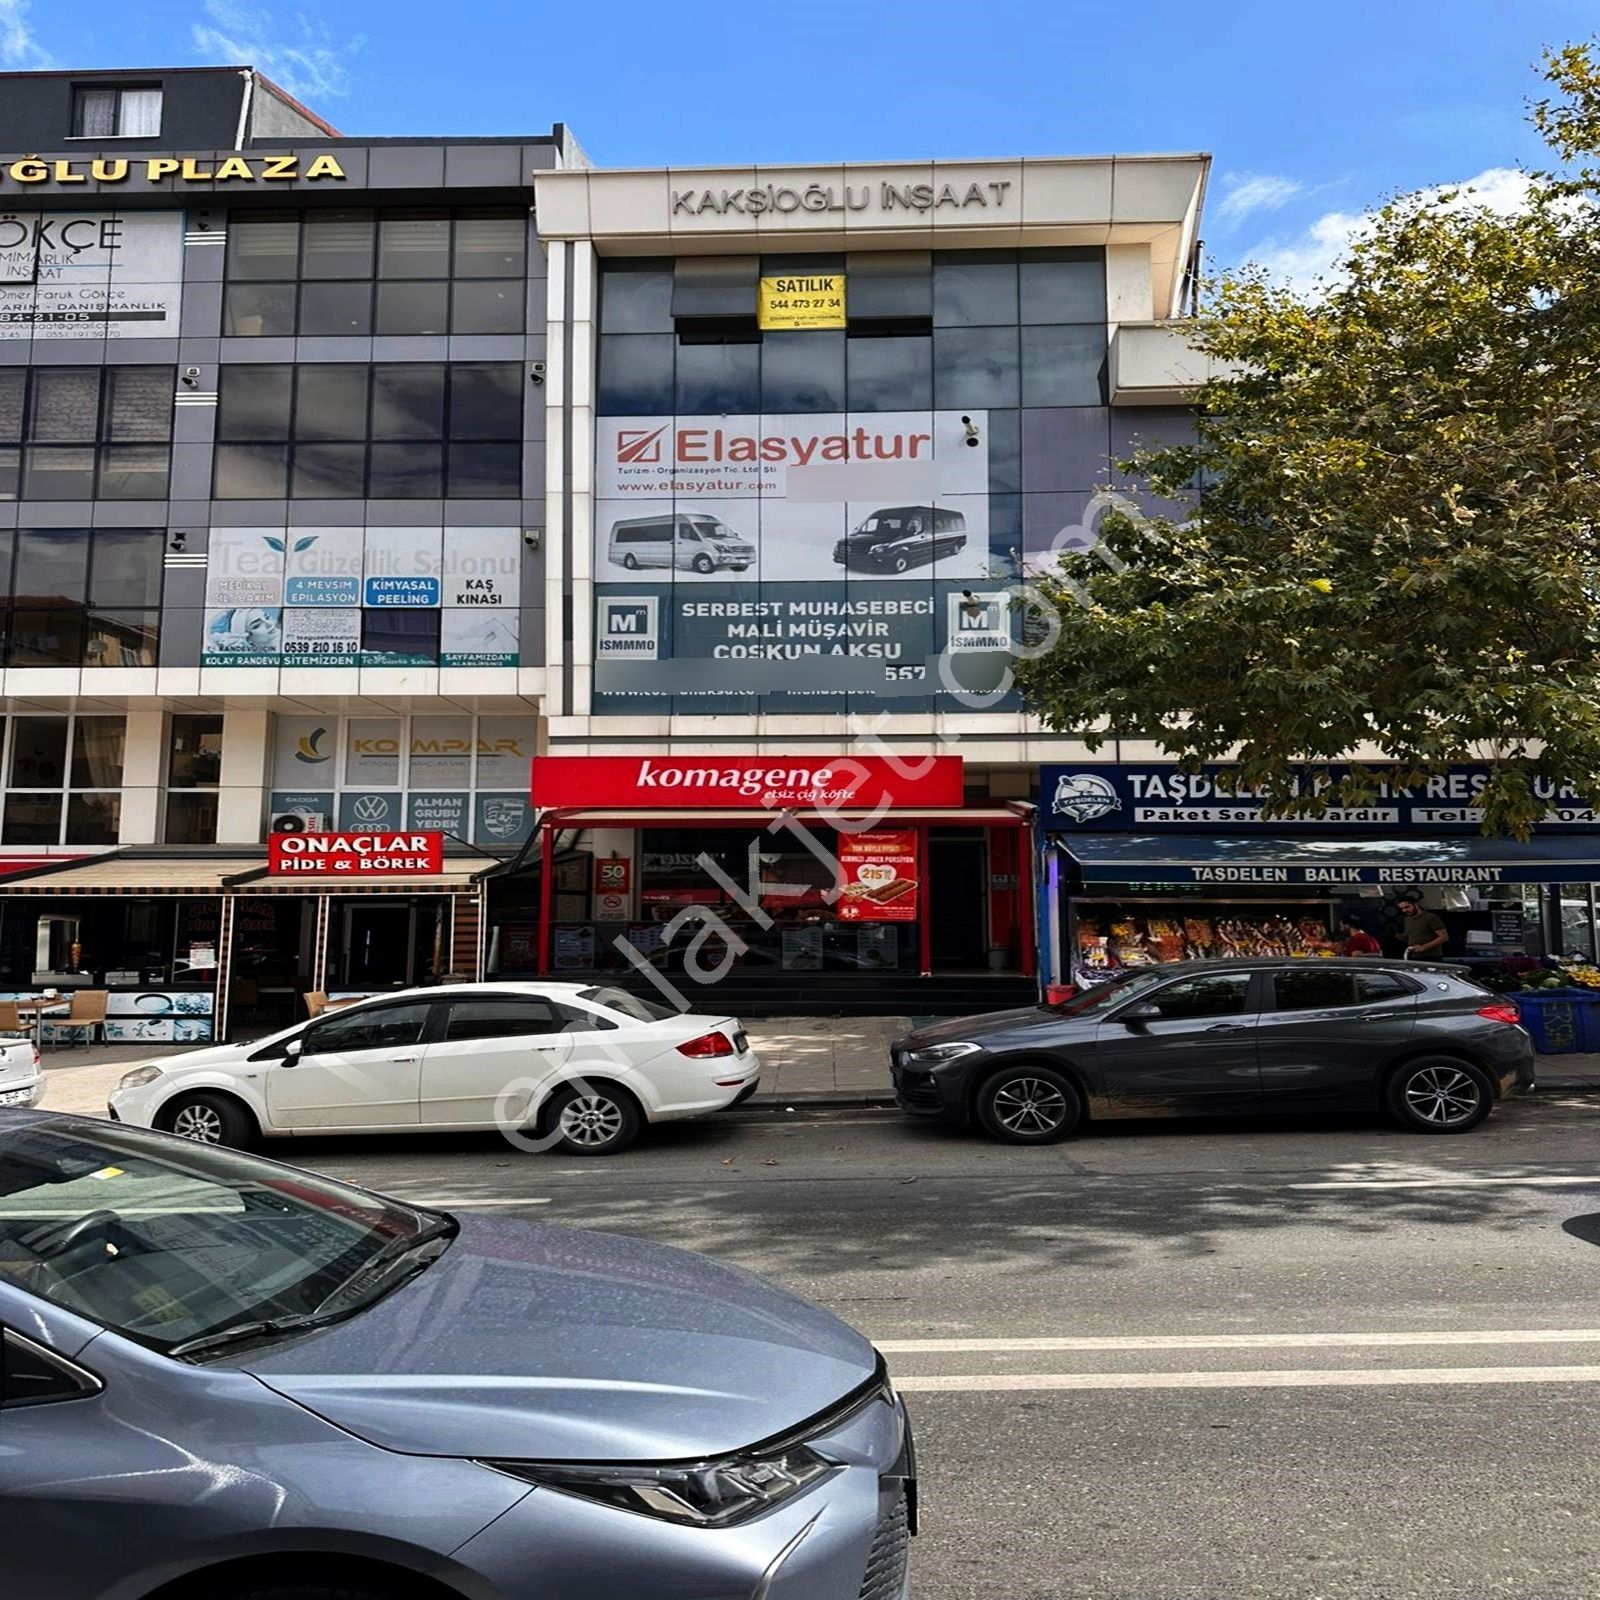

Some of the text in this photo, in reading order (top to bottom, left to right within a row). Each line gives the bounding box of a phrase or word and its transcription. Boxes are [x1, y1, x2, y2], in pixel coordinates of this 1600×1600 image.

[0, 153, 346, 182] ĞLU PLAZA
[673, 181, 1011, 218] KAKŞİOĞLU İNŞAAT
[776, 279, 834, 292] SATILIK
[770, 298, 841, 309] 544 473 27 34
[677, 427, 931, 466] Elasyatur
[618, 480, 777, 493] www.elasyatur.com
[372, 577, 435, 590] KİMYASAL
[466, 579, 494, 592] KAŞ
[377, 591, 429, 604] PEELİNG
[682, 597, 934, 617] SERBEST MUHASEBECİ
[727, 619, 890, 640] MALİ MÜŞAVİR
[284, 641, 358, 653] 0539 210 16 10
[205, 656, 234, 665] KOLAY
[284, 653, 354, 665] SİTEMİZDEN
[635, 760, 834, 797] komagene
[763, 788, 796, 800] etsiz
[819, 788, 856, 801] köfte
[414, 798, 462, 807] ALMAN
[415, 809, 461, 818] GRUBU
[1143, 809, 1211, 821] Paket
[1218, 809, 1307, 821] Serisi
[1419, 809, 1478, 822] Tel:
[415, 820, 459, 829] YEDEK
[281, 836, 429, 856] ONAÇLAR
[281, 855, 431, 871] PİDE & BÖREK
[601, 865, 625, 879] 50
[1305, 867, 1362, 881] BALIK
[1378, 867, 1503, 882] RESTAURANT
